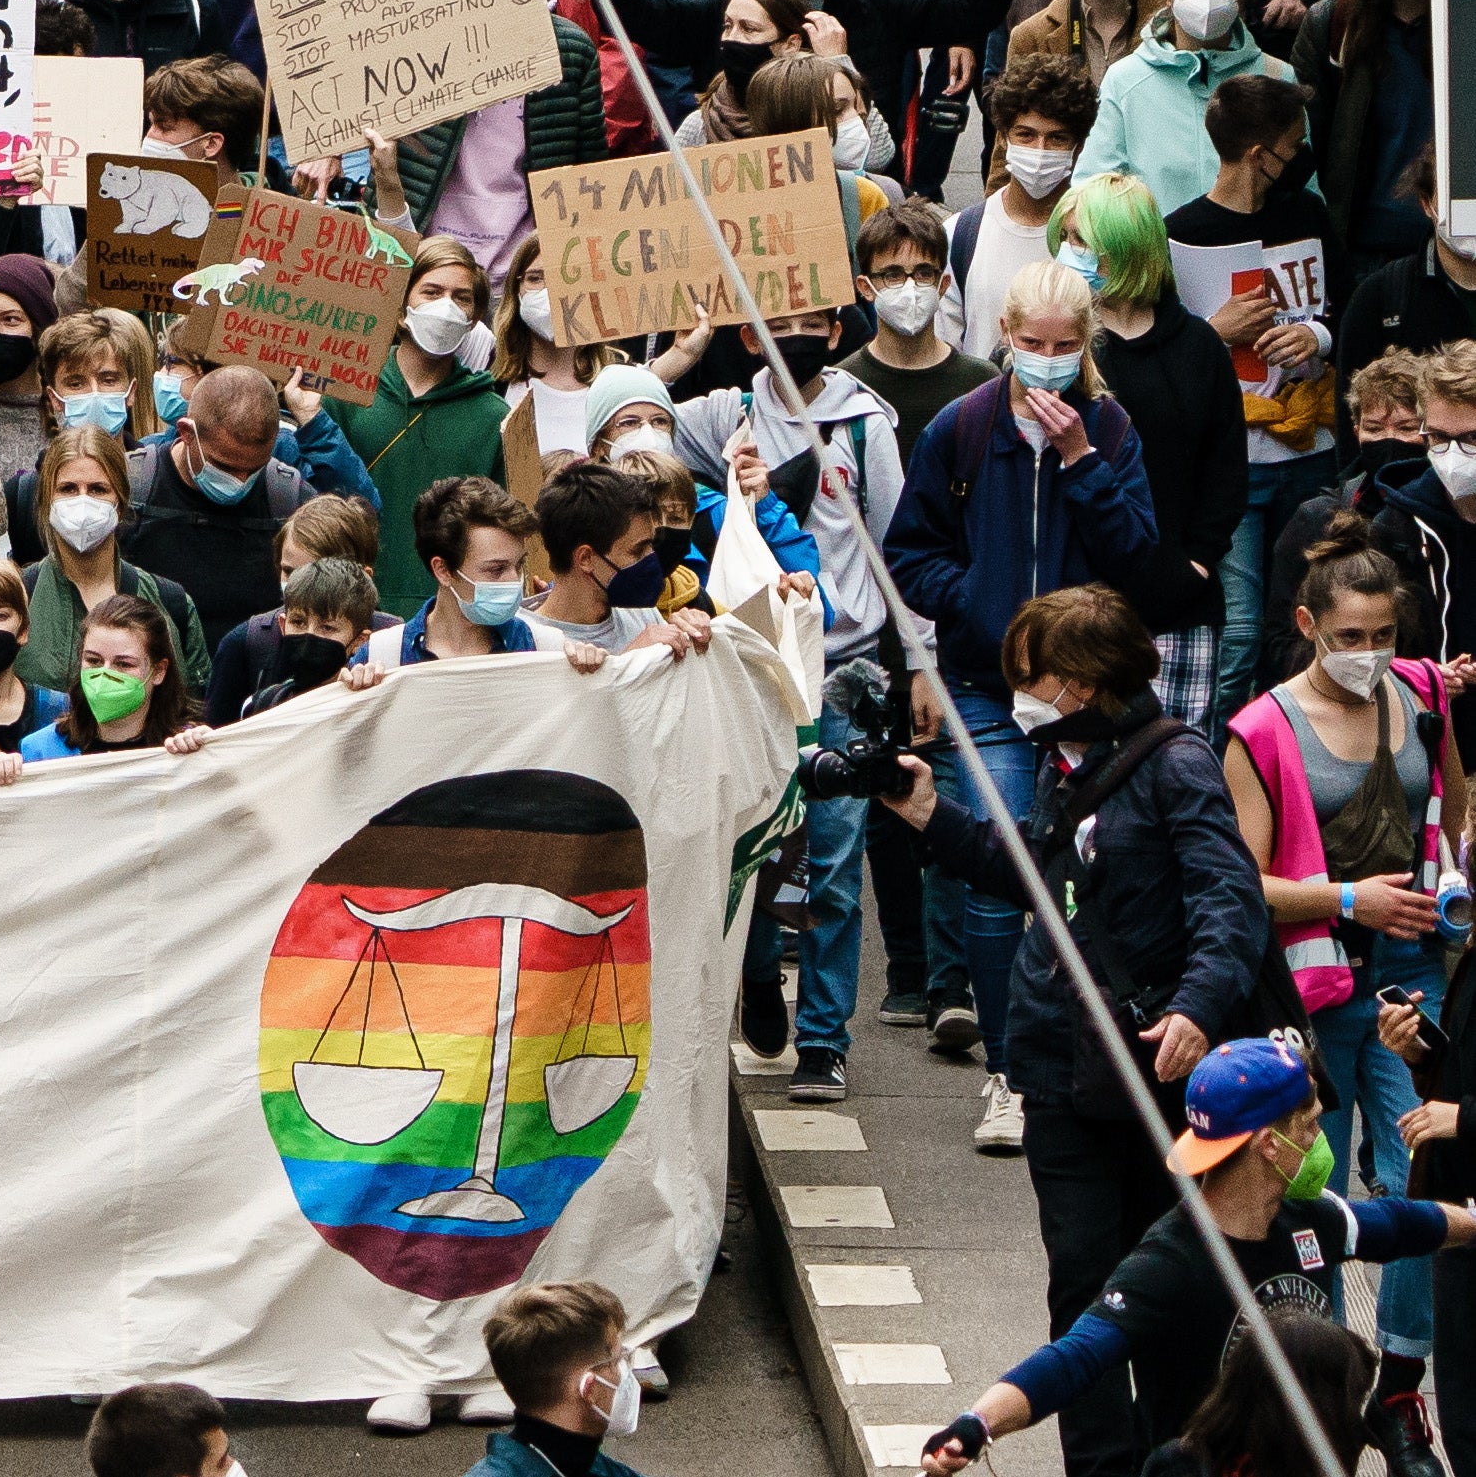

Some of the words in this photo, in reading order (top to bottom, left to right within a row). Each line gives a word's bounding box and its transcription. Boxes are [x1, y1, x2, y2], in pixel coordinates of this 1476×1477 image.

[382, 1, 416, 20] AND
[275, 12, 323, 49] STOP
[283, 40, 331, 75] STOP
[288, 72, 344, 130] ACT
[364, 42, 451, 107] NOW
[303, 101, 386, 156] AGAINST
[393, 79, 466, 124] CLIMATE
[470, 55, 539, 97] CHANGE
[540, 175, 606, 228] 1,4
[249, 198, 301, 243] ICH
[315, 215, 368, 255] BIN
[96, 240, 157, 268] Rettet
[238, 232, 284, 265] MIR
[560, 224, 690, 285] GEGEN
[717, 210, 797, 259] DEN
[99, 273, 177, 293] Lebensr
[223, 311, 310, 347] DACHTEN
[218, 334, 249, 356] SIE
[328, 361, 377, 392] NOCH
